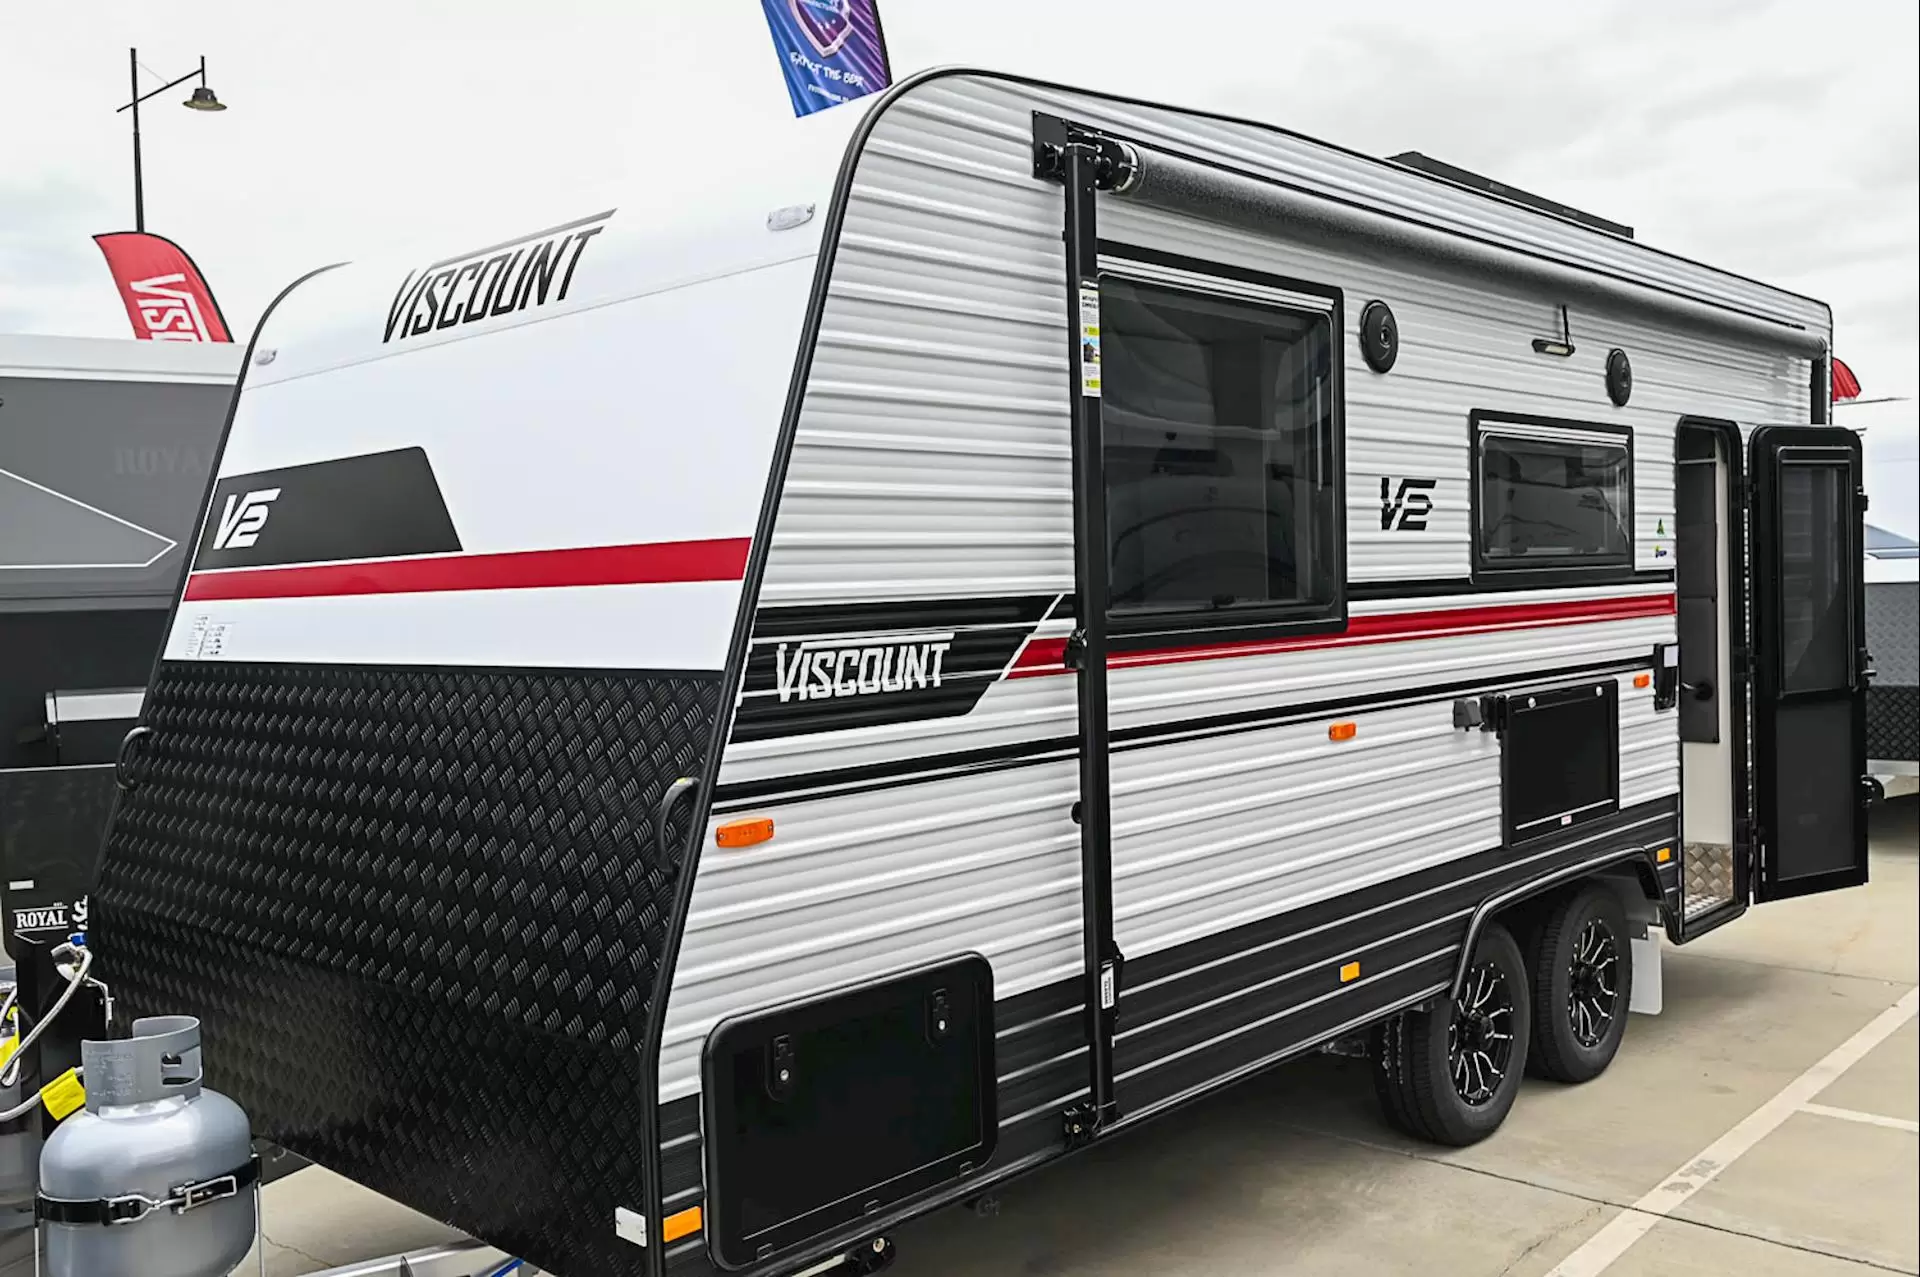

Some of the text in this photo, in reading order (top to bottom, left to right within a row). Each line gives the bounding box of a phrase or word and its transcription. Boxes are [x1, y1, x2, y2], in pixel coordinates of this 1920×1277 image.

[823, 66, 842, 81] THE
[383, 207, 617, 344] VISCOUNT
[115, 446, 208, 475] ROYA
[212, 487, 281, 550] V2
[1381, 477, 1437, 531] V2
[776, 632, 956, 703] VISCOUNT
[16, 910, 68, 928] ROYAL
